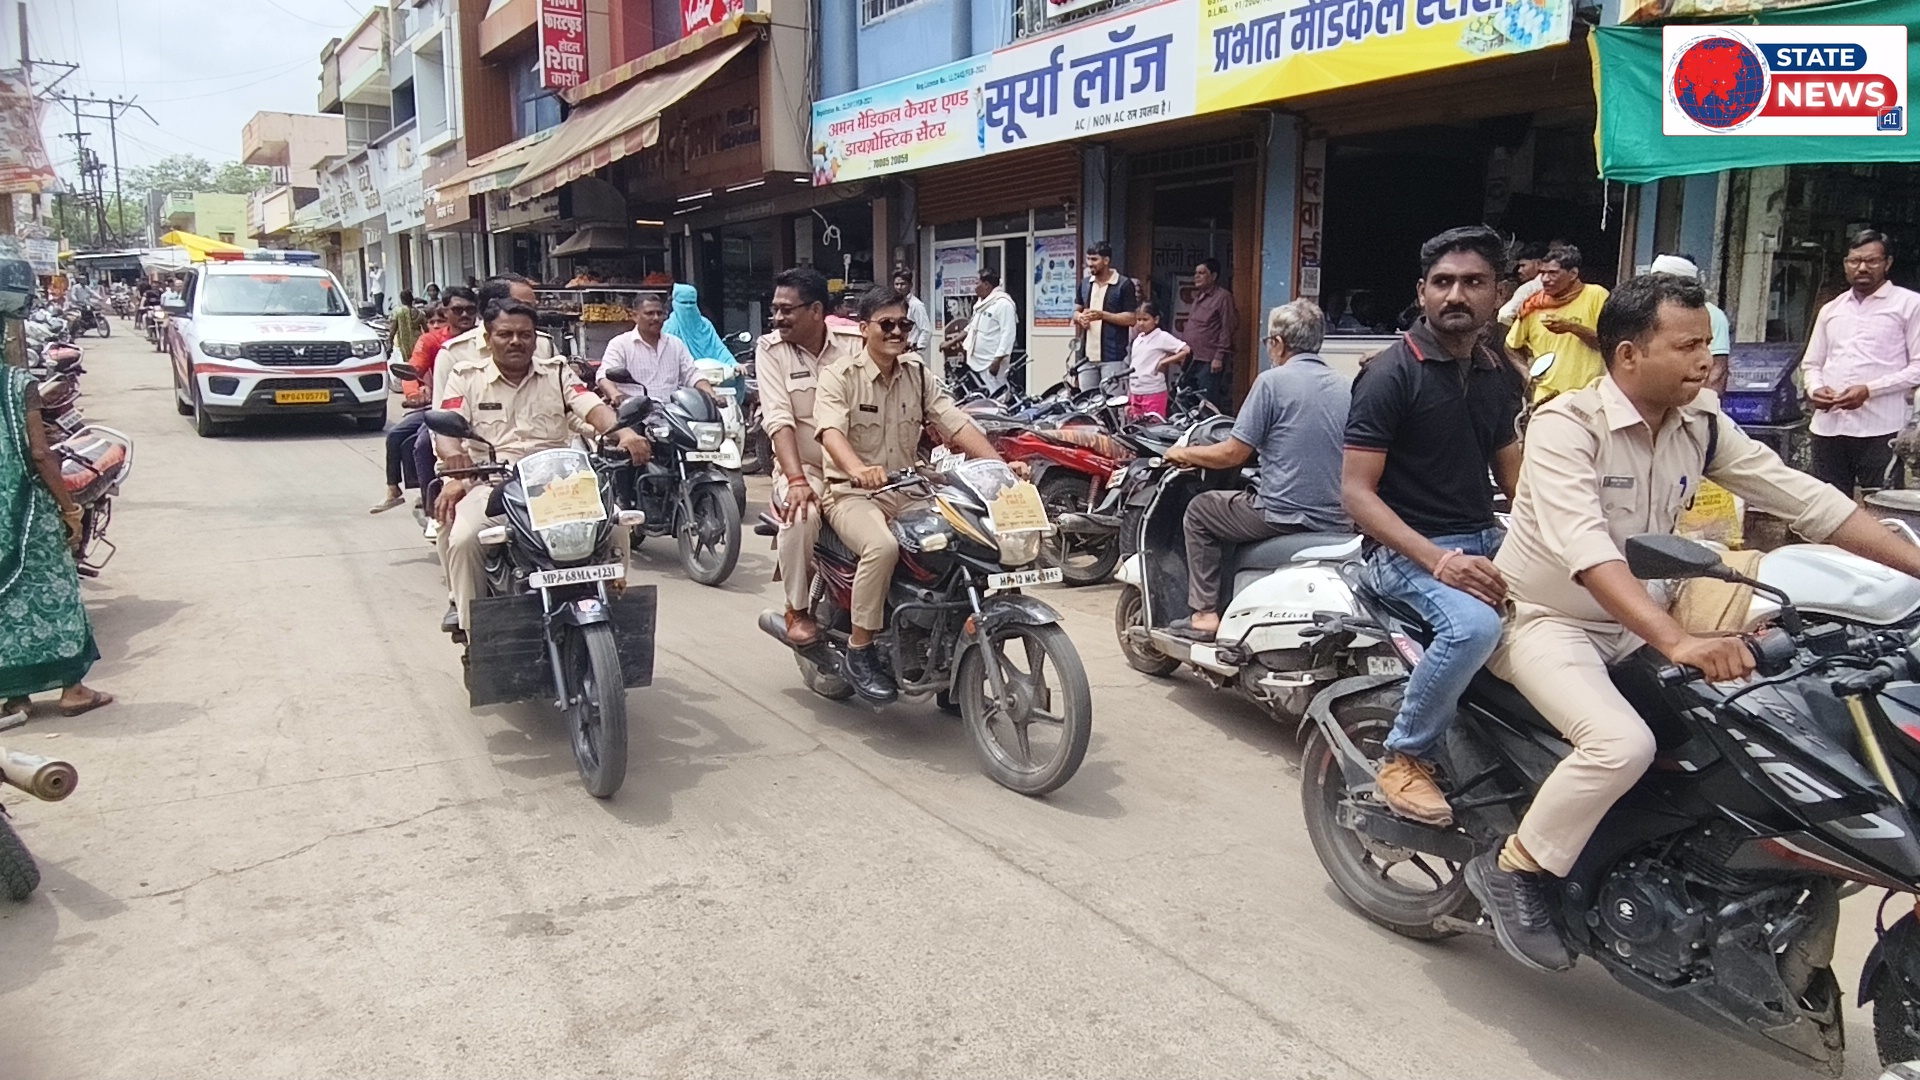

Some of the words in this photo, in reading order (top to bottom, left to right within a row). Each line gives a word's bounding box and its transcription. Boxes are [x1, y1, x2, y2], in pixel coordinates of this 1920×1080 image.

[545, 47, 584, 72] शिवा
[558, 38, 581, 53] होटल
[1214, 12, 1285, 72] प्रभात
[985, 44, 1064, 144] सूर्या
[1070, 24, 1173, 108] लॉज
[828, 119, 855, 137] अमन
[858, 108, 901, 130] मेडिकल
[904, 97, 938, 119] केयर
[942, 90, 970, 114] एण्ड
[1074, 118, 1085, 131] AC
[1093, 113, 1111, 127] NON
[1114, 110, 1125, 123] AC
